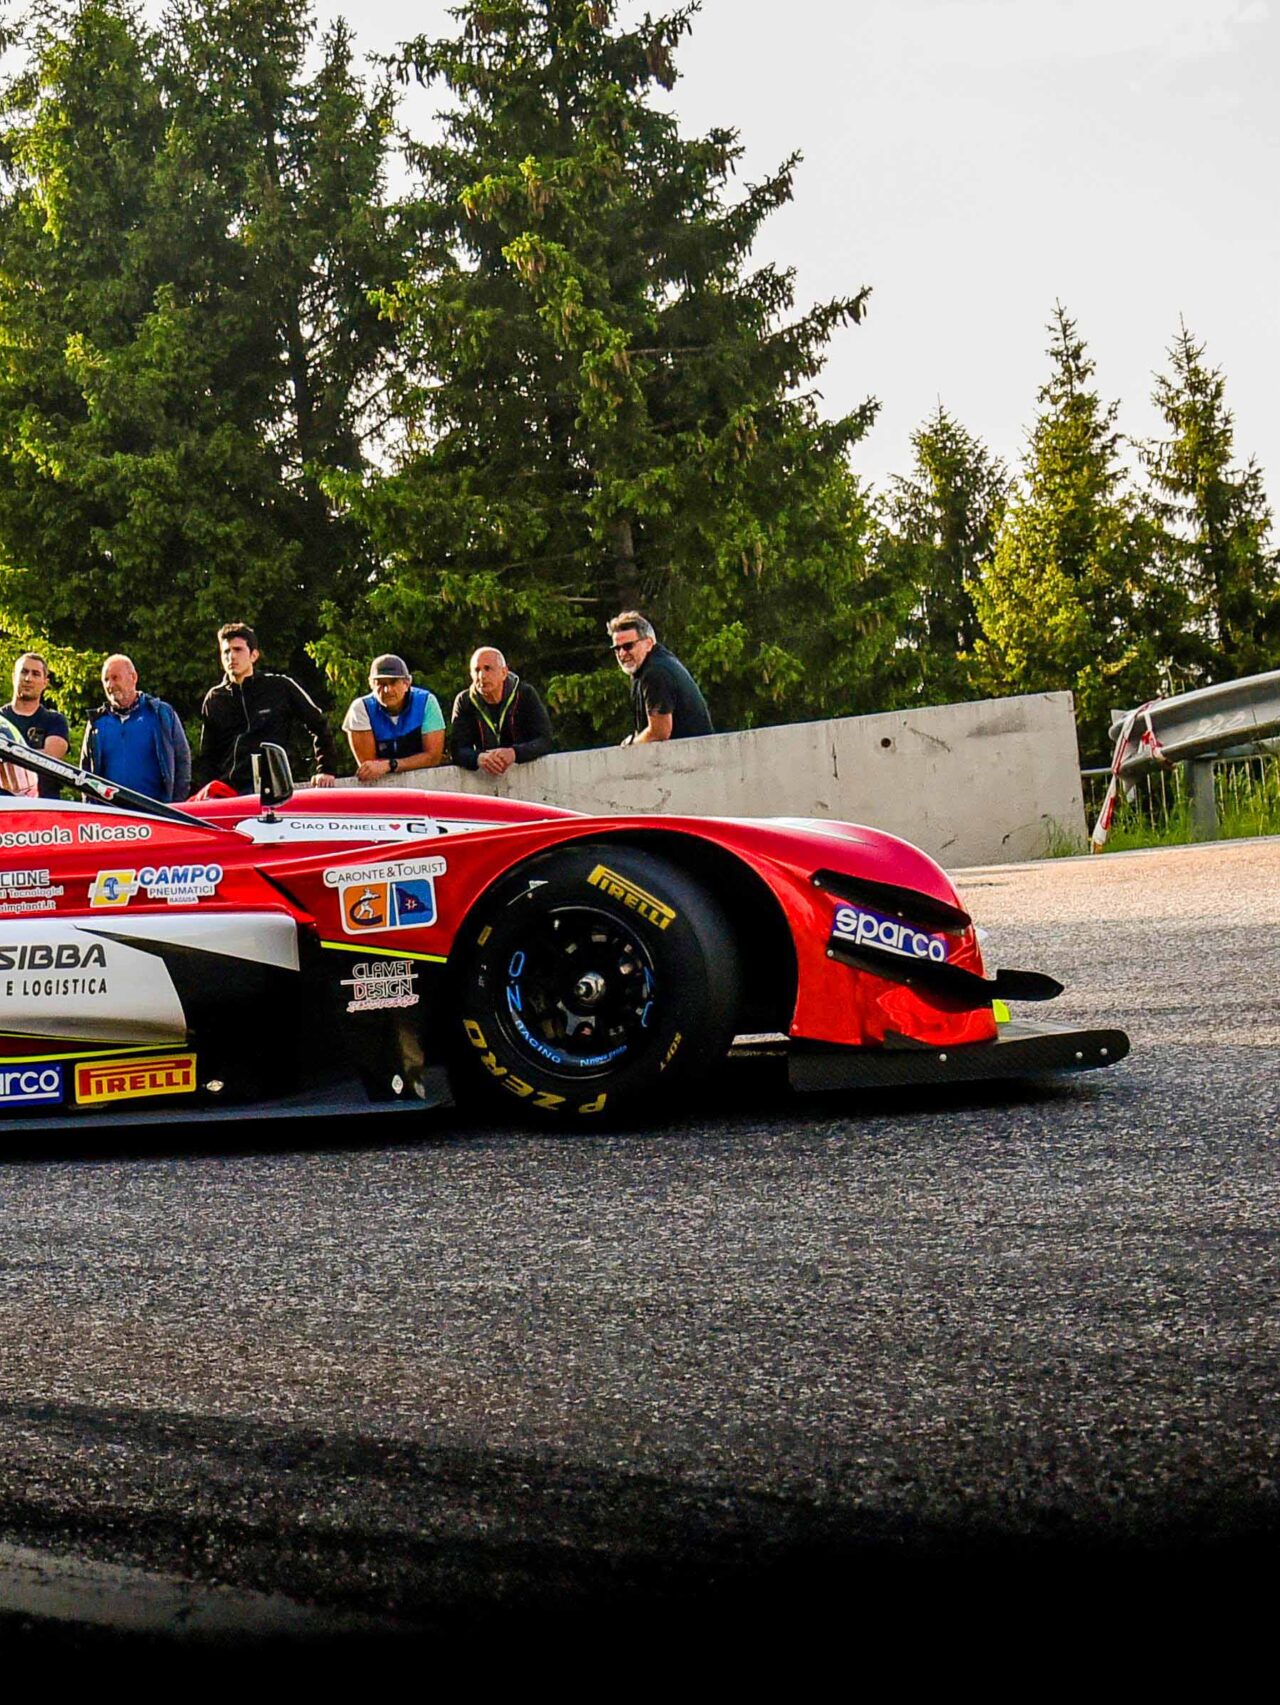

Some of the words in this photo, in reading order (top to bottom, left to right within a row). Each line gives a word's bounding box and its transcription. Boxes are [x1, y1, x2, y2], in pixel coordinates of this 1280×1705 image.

[78, 825, 150, 842] Nicaso
[290, 821, 324, 830] CIAO
[328, 821, 386, 832] DANIELE
[139, 866, 221, 885] CAMPO
[149, 885, 213, 896] PNEUMATICI
[587, 864, 677, 931] PIRELLI
[833, 908, 945, 962] sparco
[352, 960, 415, 979] CLAVET
[6, 980, 13, 996] E
[23, 978, 107, 997] LOGISTICA
[353, 979, 413, 1000] DESIGN
[462, 1019, 566, 1111] ZERO
[79, 1058, 193, 1097] PIRELLI
[578, 1093, 608, 1114] P
